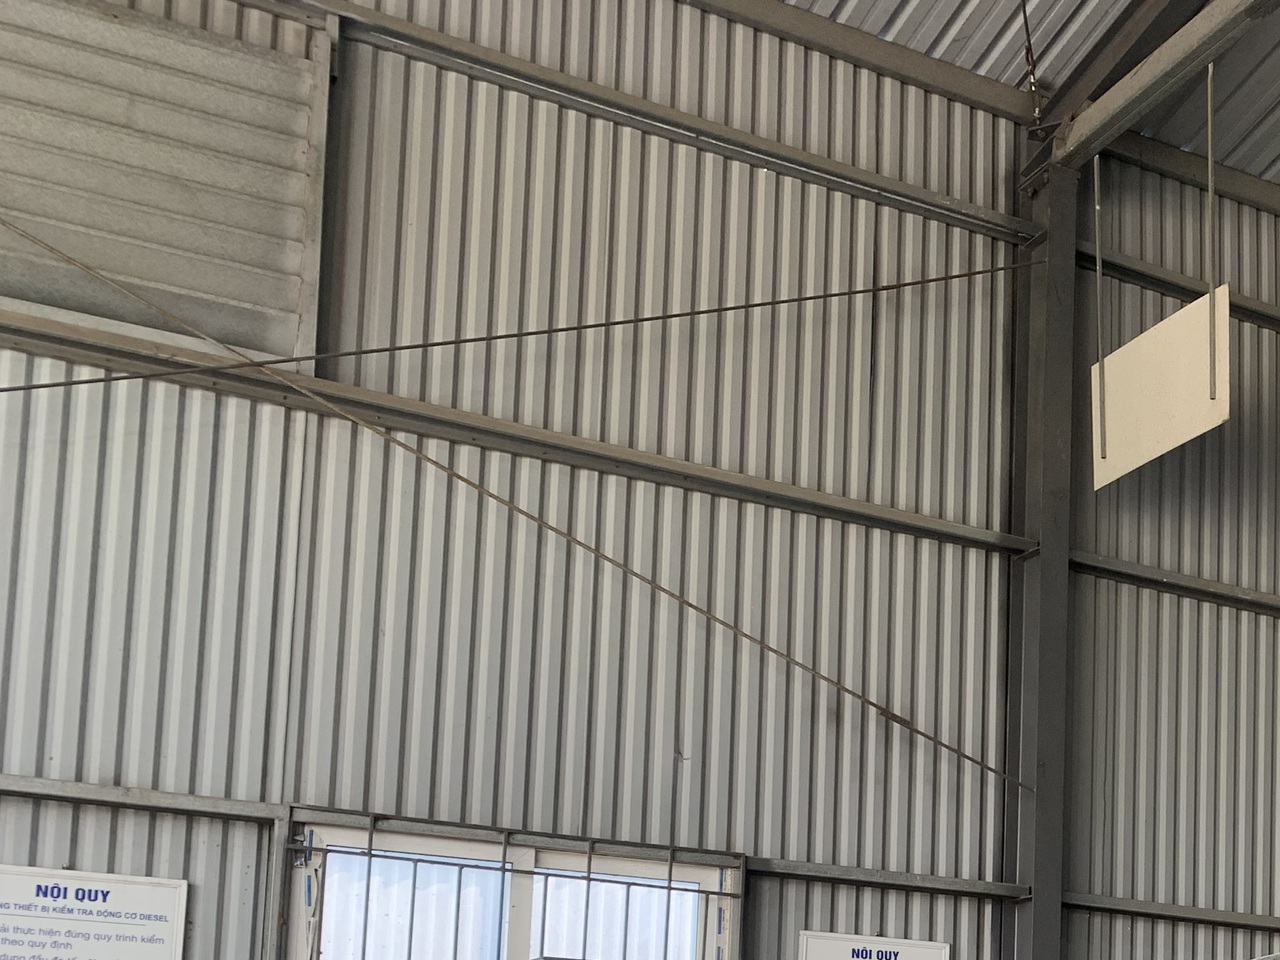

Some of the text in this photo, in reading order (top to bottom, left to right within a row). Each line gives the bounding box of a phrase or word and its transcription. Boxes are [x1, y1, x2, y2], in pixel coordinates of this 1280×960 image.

[35, 883, 111, 903] NỘI QUY
[76, 908, 94, 916] TRA
[139, 913, 169, 923] DIESEL
[1, 937, 25, 947] theo
[28, 940, 47, 950] quy
[93, 933, 112, 943] quy
